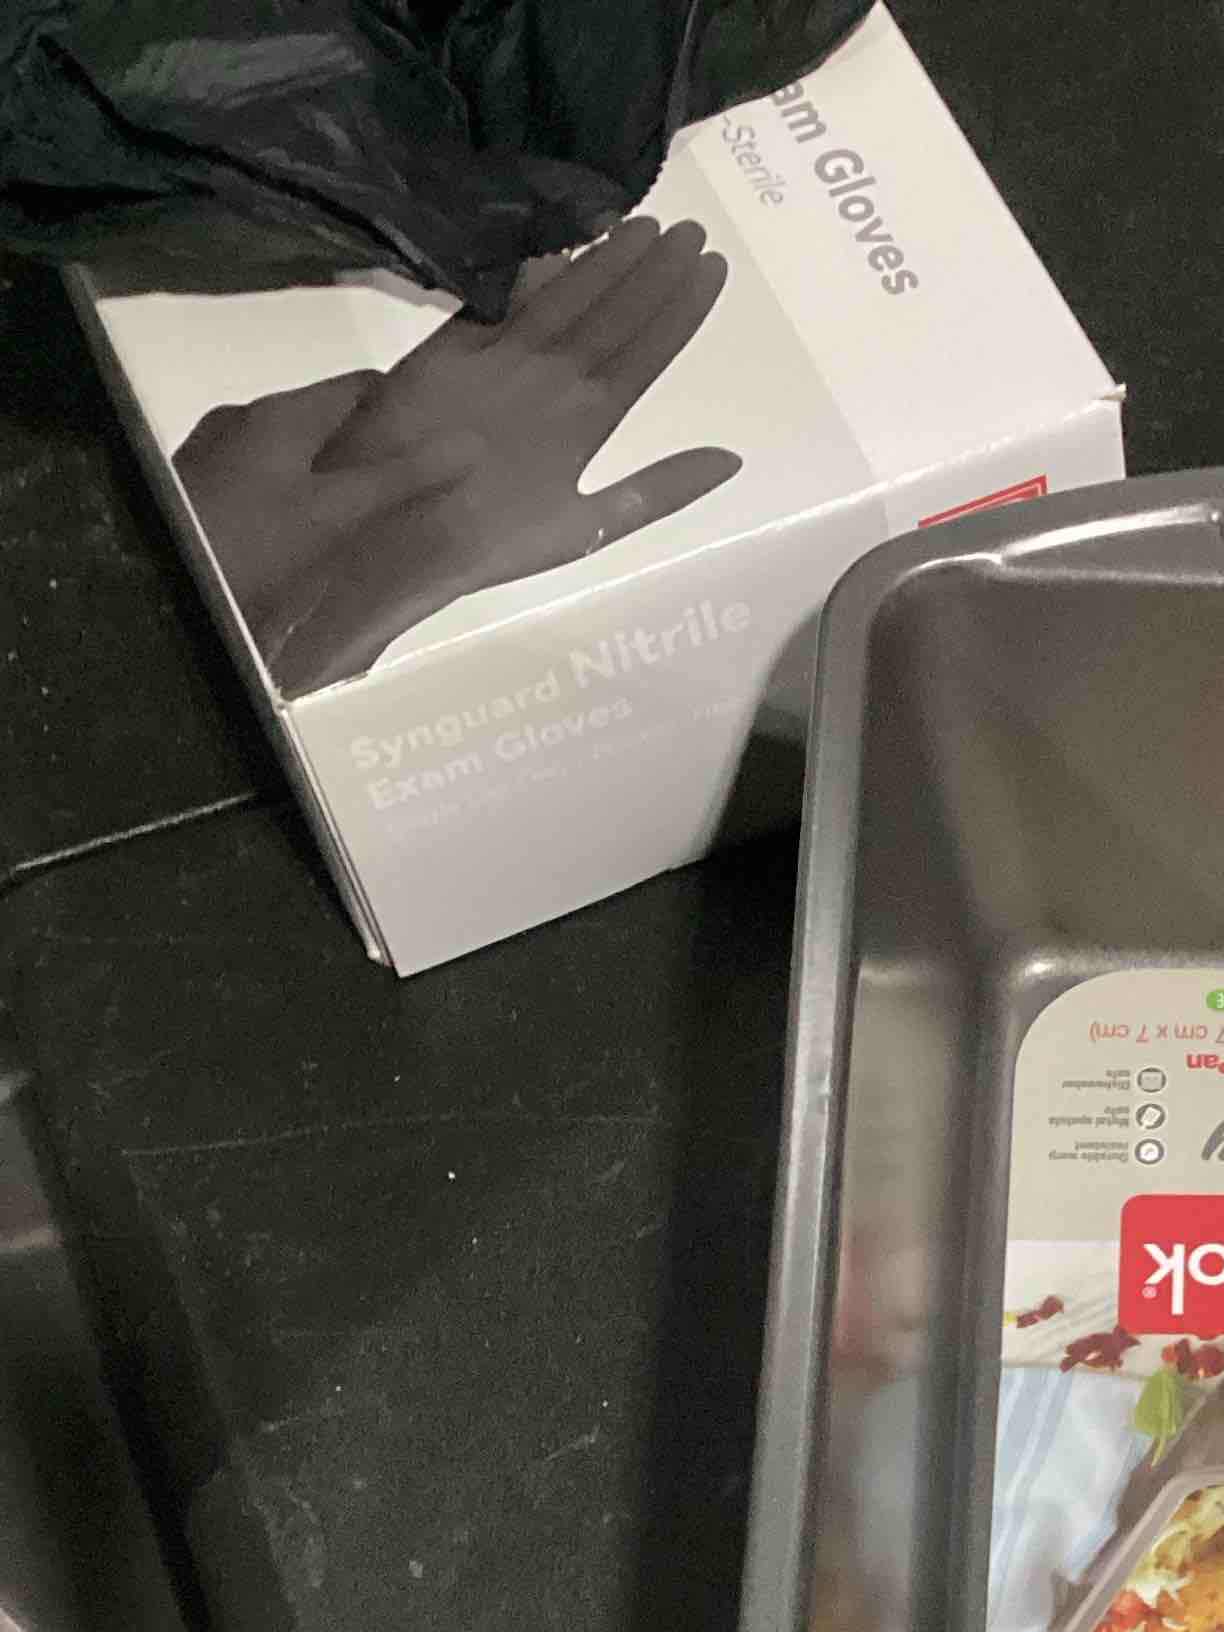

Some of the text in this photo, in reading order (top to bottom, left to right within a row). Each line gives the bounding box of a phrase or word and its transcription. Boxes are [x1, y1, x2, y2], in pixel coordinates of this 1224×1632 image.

[814, 148, 919, 295] Gloves
[349, 670, 561, 770] Synguard
[569, 598, 751, 688] Nitrile
[366, 750, 485, 811] Exam
[494, 696, 632, 762] Gloves
[1089, 1021, 1130, 1043] cm)
[1136, 1023, 1148, 1043] 7
[1156, 1024, 1168, 1039] x
[1174, 1024, 1208, 1040] cm
